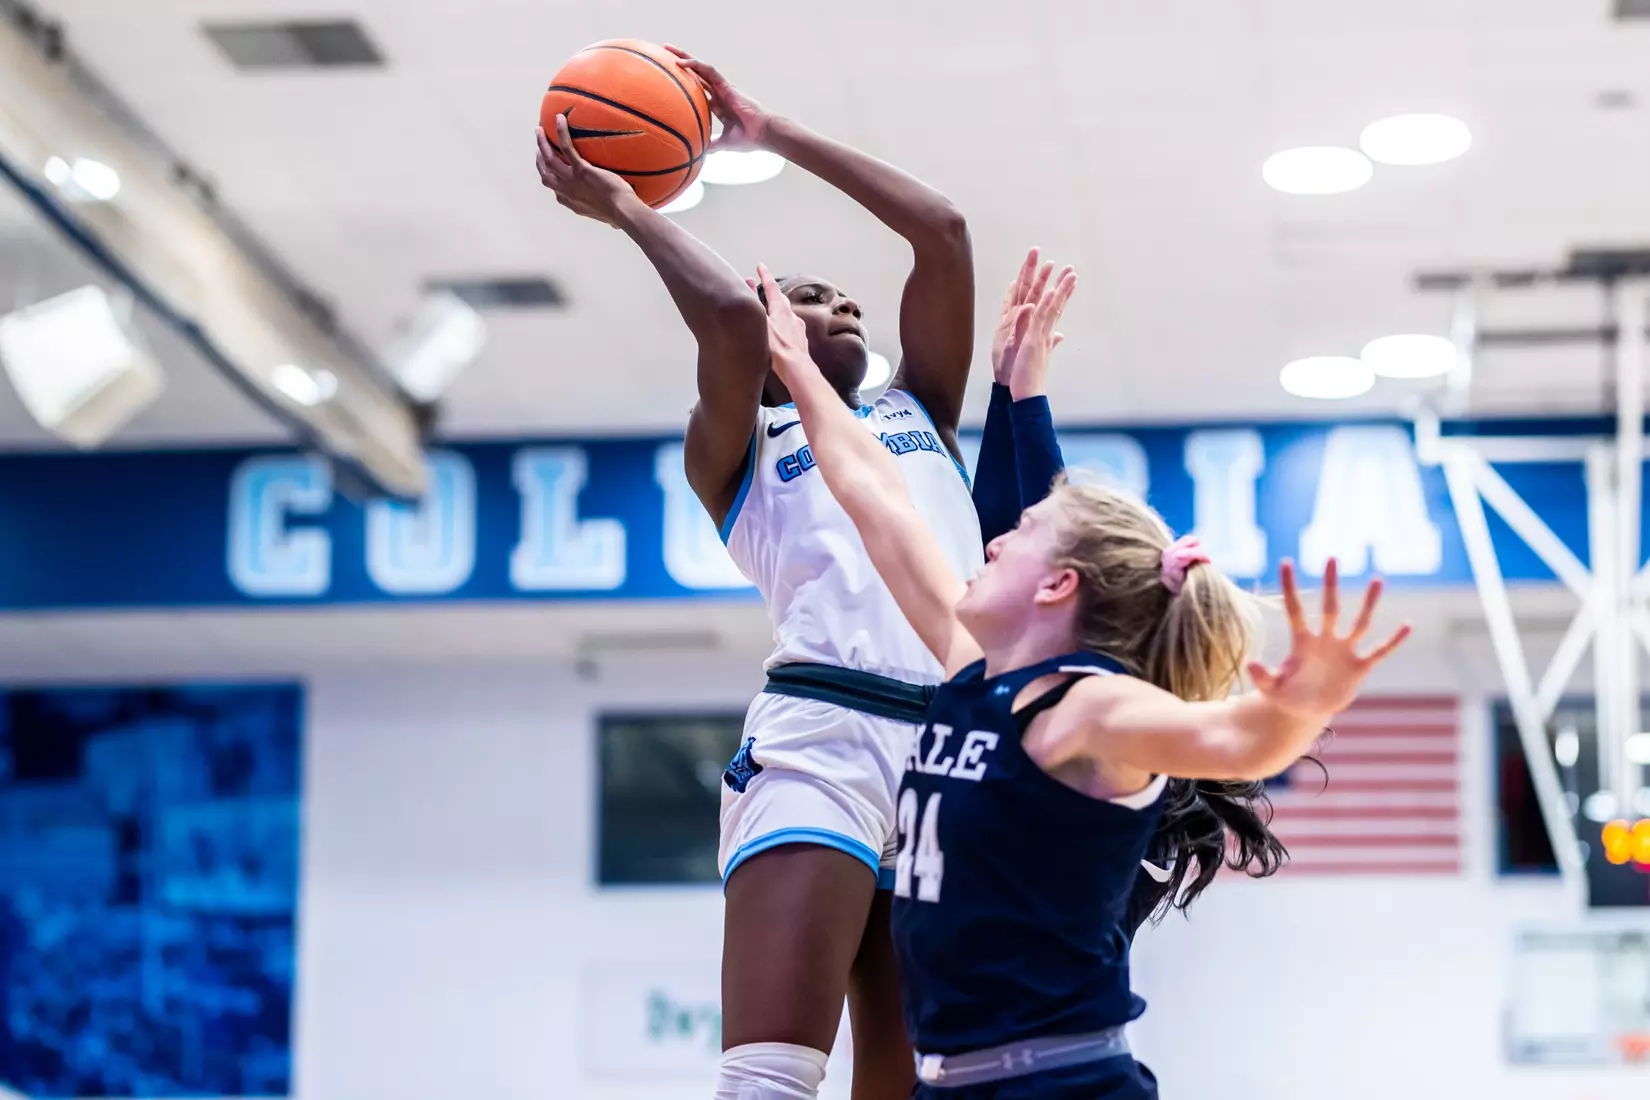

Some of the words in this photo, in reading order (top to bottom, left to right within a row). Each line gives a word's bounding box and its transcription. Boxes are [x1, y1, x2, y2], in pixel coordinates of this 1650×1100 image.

[776, 430, 947, 483] COMBIA
[226, 425, 1443, 597] COLUIA
[905, 722, 1000, 782] ALE
[894, 787, 945, 904] 24
